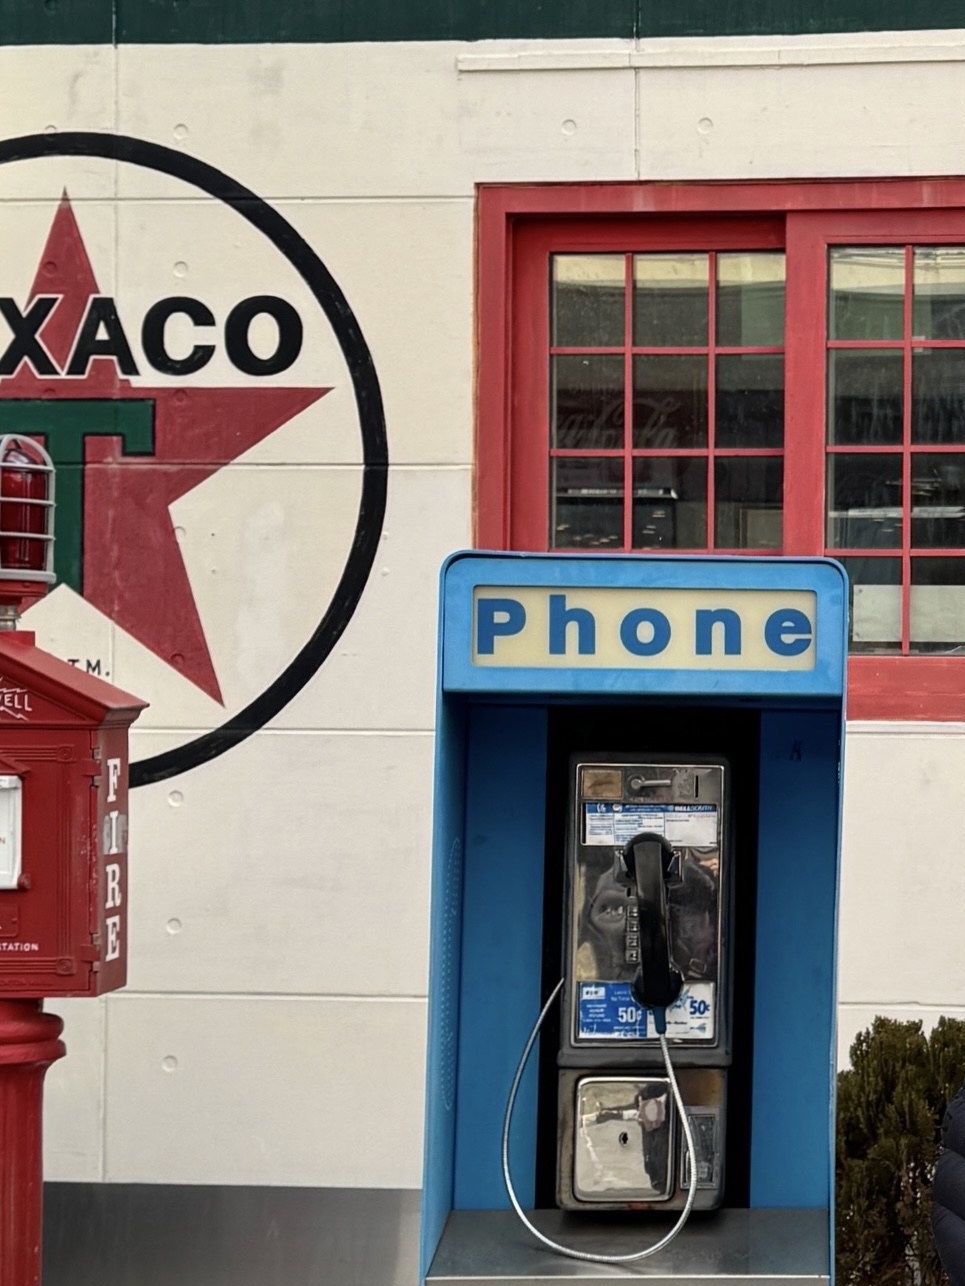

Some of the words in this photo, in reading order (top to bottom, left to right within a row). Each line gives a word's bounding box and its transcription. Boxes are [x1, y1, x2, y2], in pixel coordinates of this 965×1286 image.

[476, 594, 813, 657] Phone
[105, 758, 121, 962] FIRE
[0, 943, 39, 951] TATION
